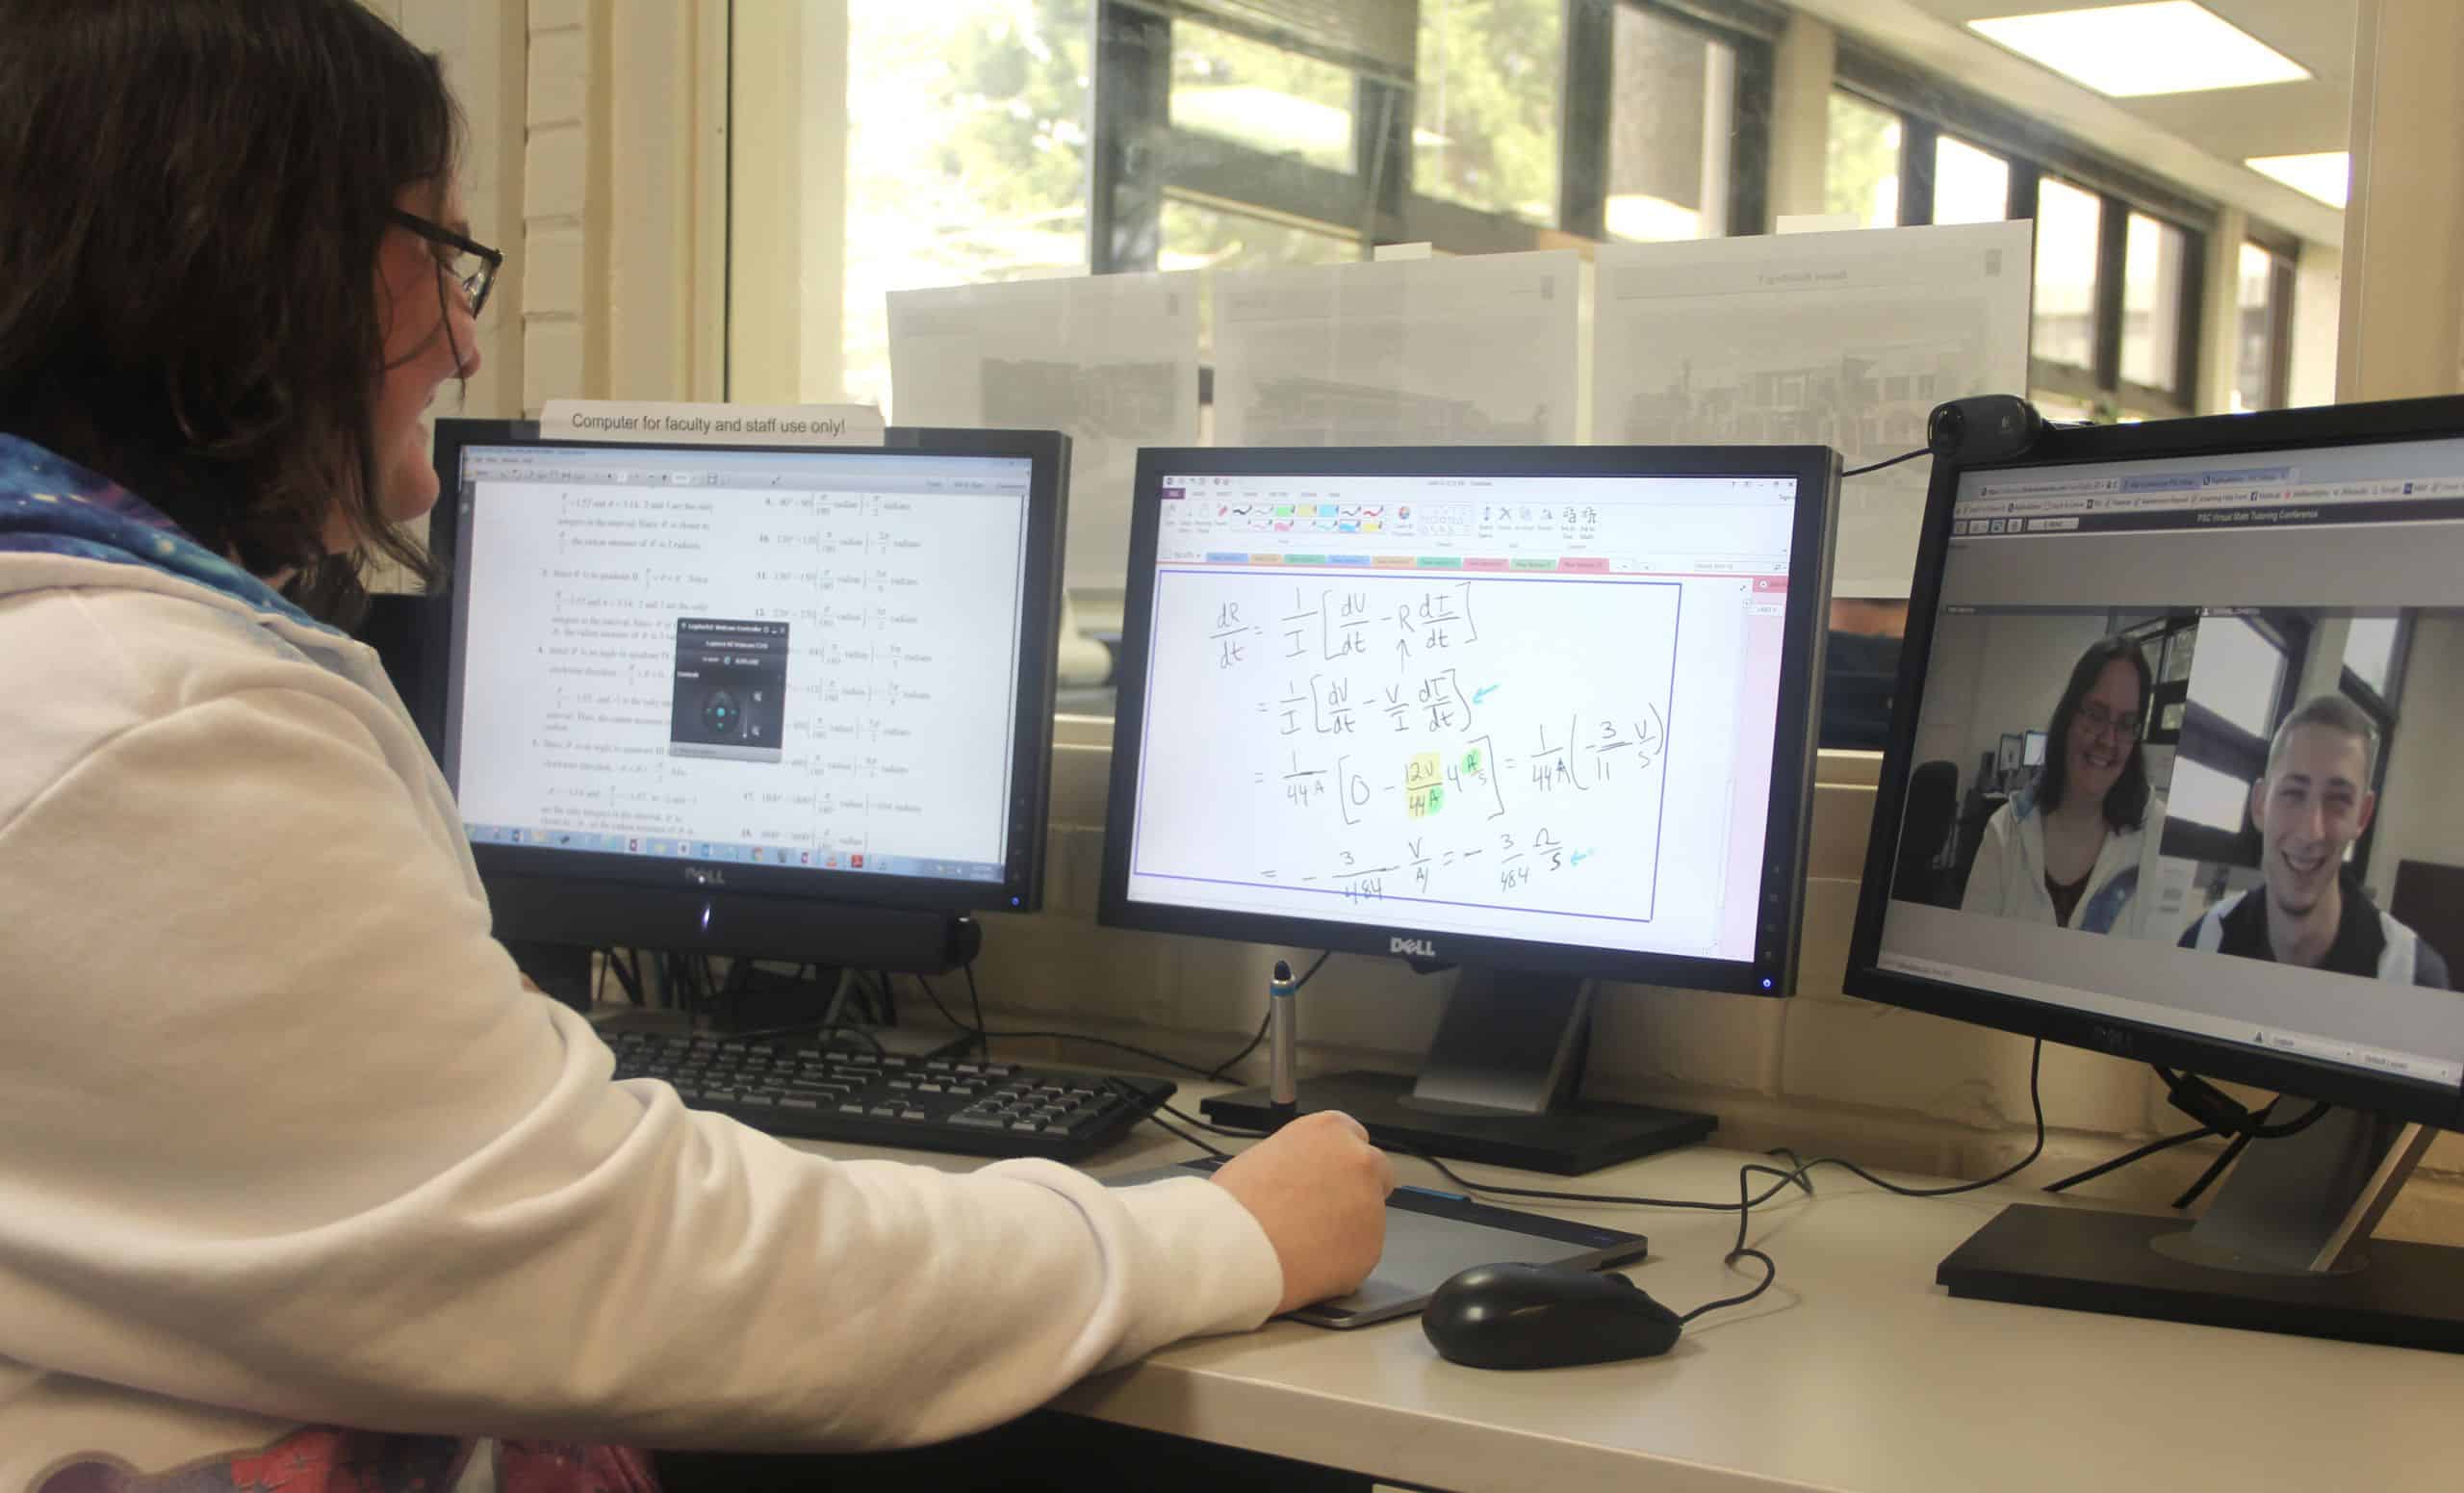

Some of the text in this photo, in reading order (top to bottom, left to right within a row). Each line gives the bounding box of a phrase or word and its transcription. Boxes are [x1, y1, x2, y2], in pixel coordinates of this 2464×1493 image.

[572, 414, 845, 437] Computer for faculty and staff use only!
[1217, 601, 1242, 628] dR
[1399, 604, 1415, 632] R
[1342, 632, 1366, 655] dt
[1426, 629, 1450, 649] dt
[1219, 642, 1245, 669] dt
[1333, 715, 1355, 734] dt
[1428, 701, 1454, 733] dt
[1448, 764, 1463, 793] 4
[1601, 721, 1617, 739] 3
[1340, 851, 1355, 865] 3
[1501, 834, 1514, 849] 3
[1502, 867, 1529, 892] 484
[1390, 937, 1436, 956] DELL
